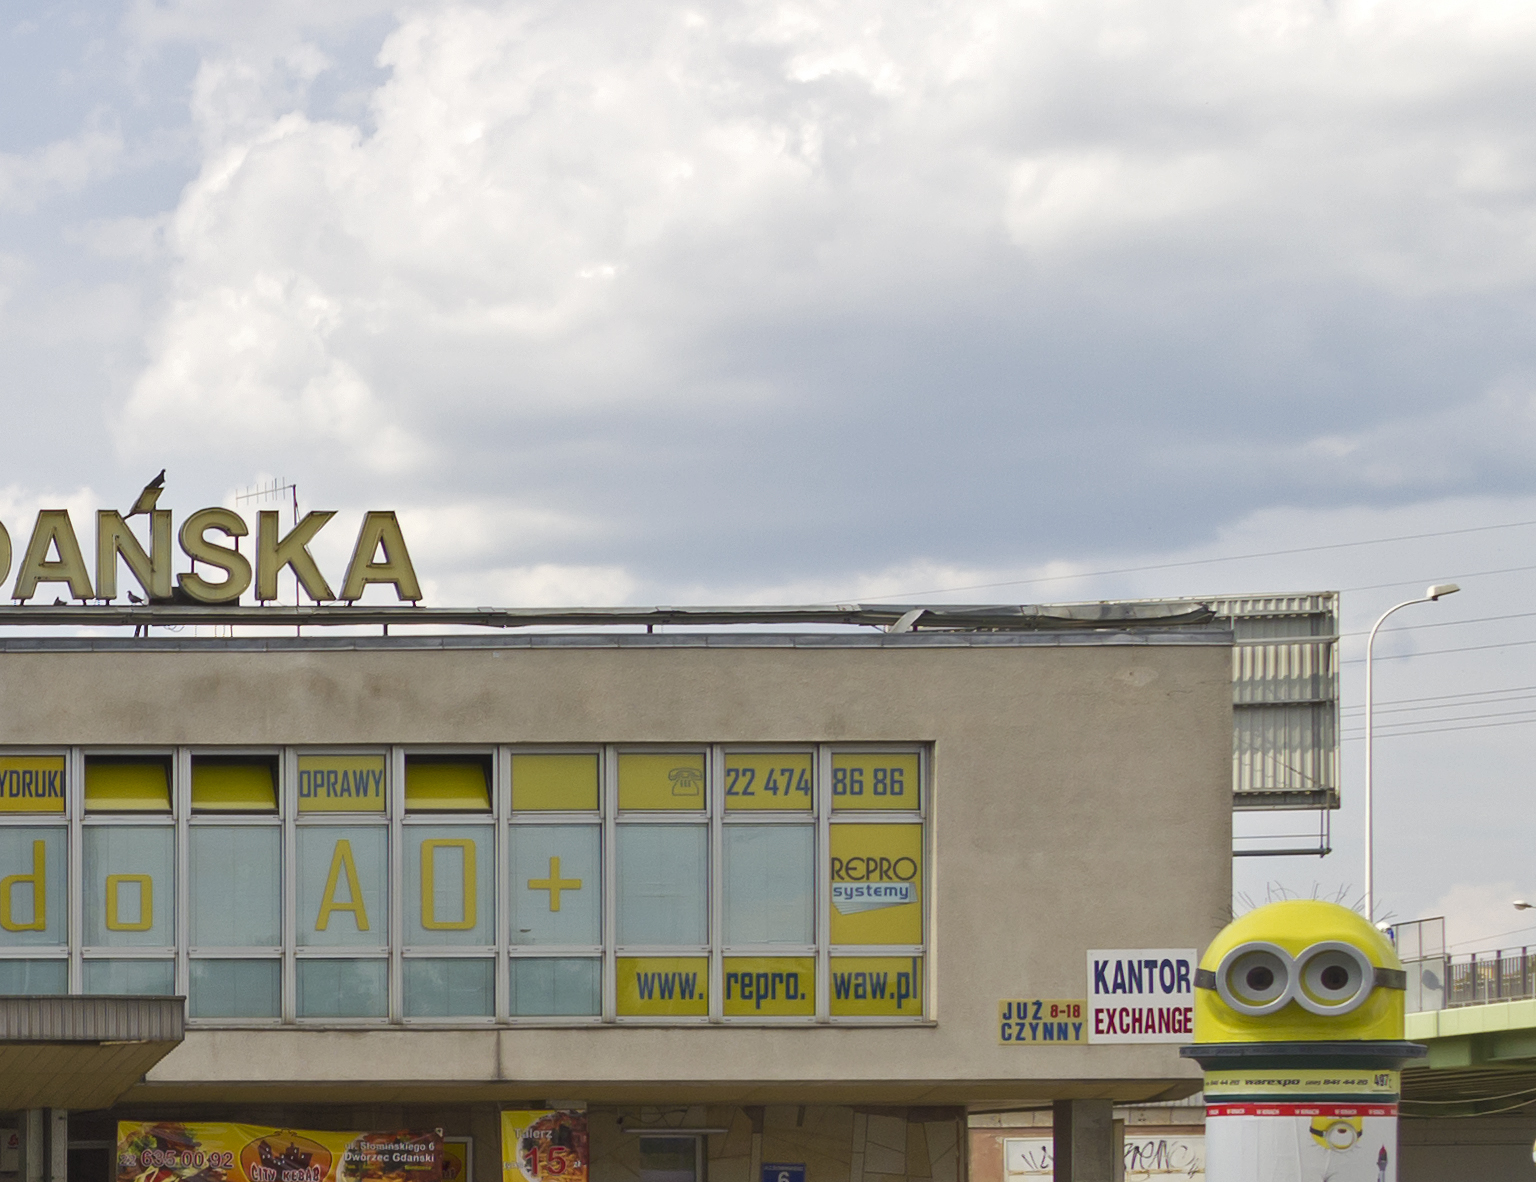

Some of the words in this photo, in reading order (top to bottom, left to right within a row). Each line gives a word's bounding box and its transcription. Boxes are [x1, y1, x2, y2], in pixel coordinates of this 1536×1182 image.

[299, 769, 384, 798] OPRAWY
[726, 767, 756, 797] 22
[763, 767, 812, 797] 474
[833, 767, 864, 797] 86
[872, 767, 905, 797] 86
[831, 856, 919, 882] REPRO
[832, 883, 910, 901] systemy
[636, 971, 705, 1001] www.
[725, 971, 806, 1010] repro.
[833, 957, 919, 1010] waw.pl
[1094, 958, 1192, 994] KANTOR
[1002, 999, 1044, 1021] JUŻ
[1050, 1004, 1081, 1019] 8-18
[1094, 1007, 1194, 1034] EXCHANGE
[1001, 1022, 1083, 1041] CZYNNY
[514, 1128, 553, 1139] Talerz
[119, 1154, 136, 1167] 22
[140, 1149, 177, 1168] 635
[180, 1150, 205, 1168] 00
[208, 1151, 234, 1168] 92
[344, 1152, 390, 1162] Dworzec
[392, 1152, 435, 1162] Gdański
[360, 1141, 426, 1152] Słomińskiego
[428, 1142, 435, 1151] 6
[524, 1145, 567, 1176] 15
